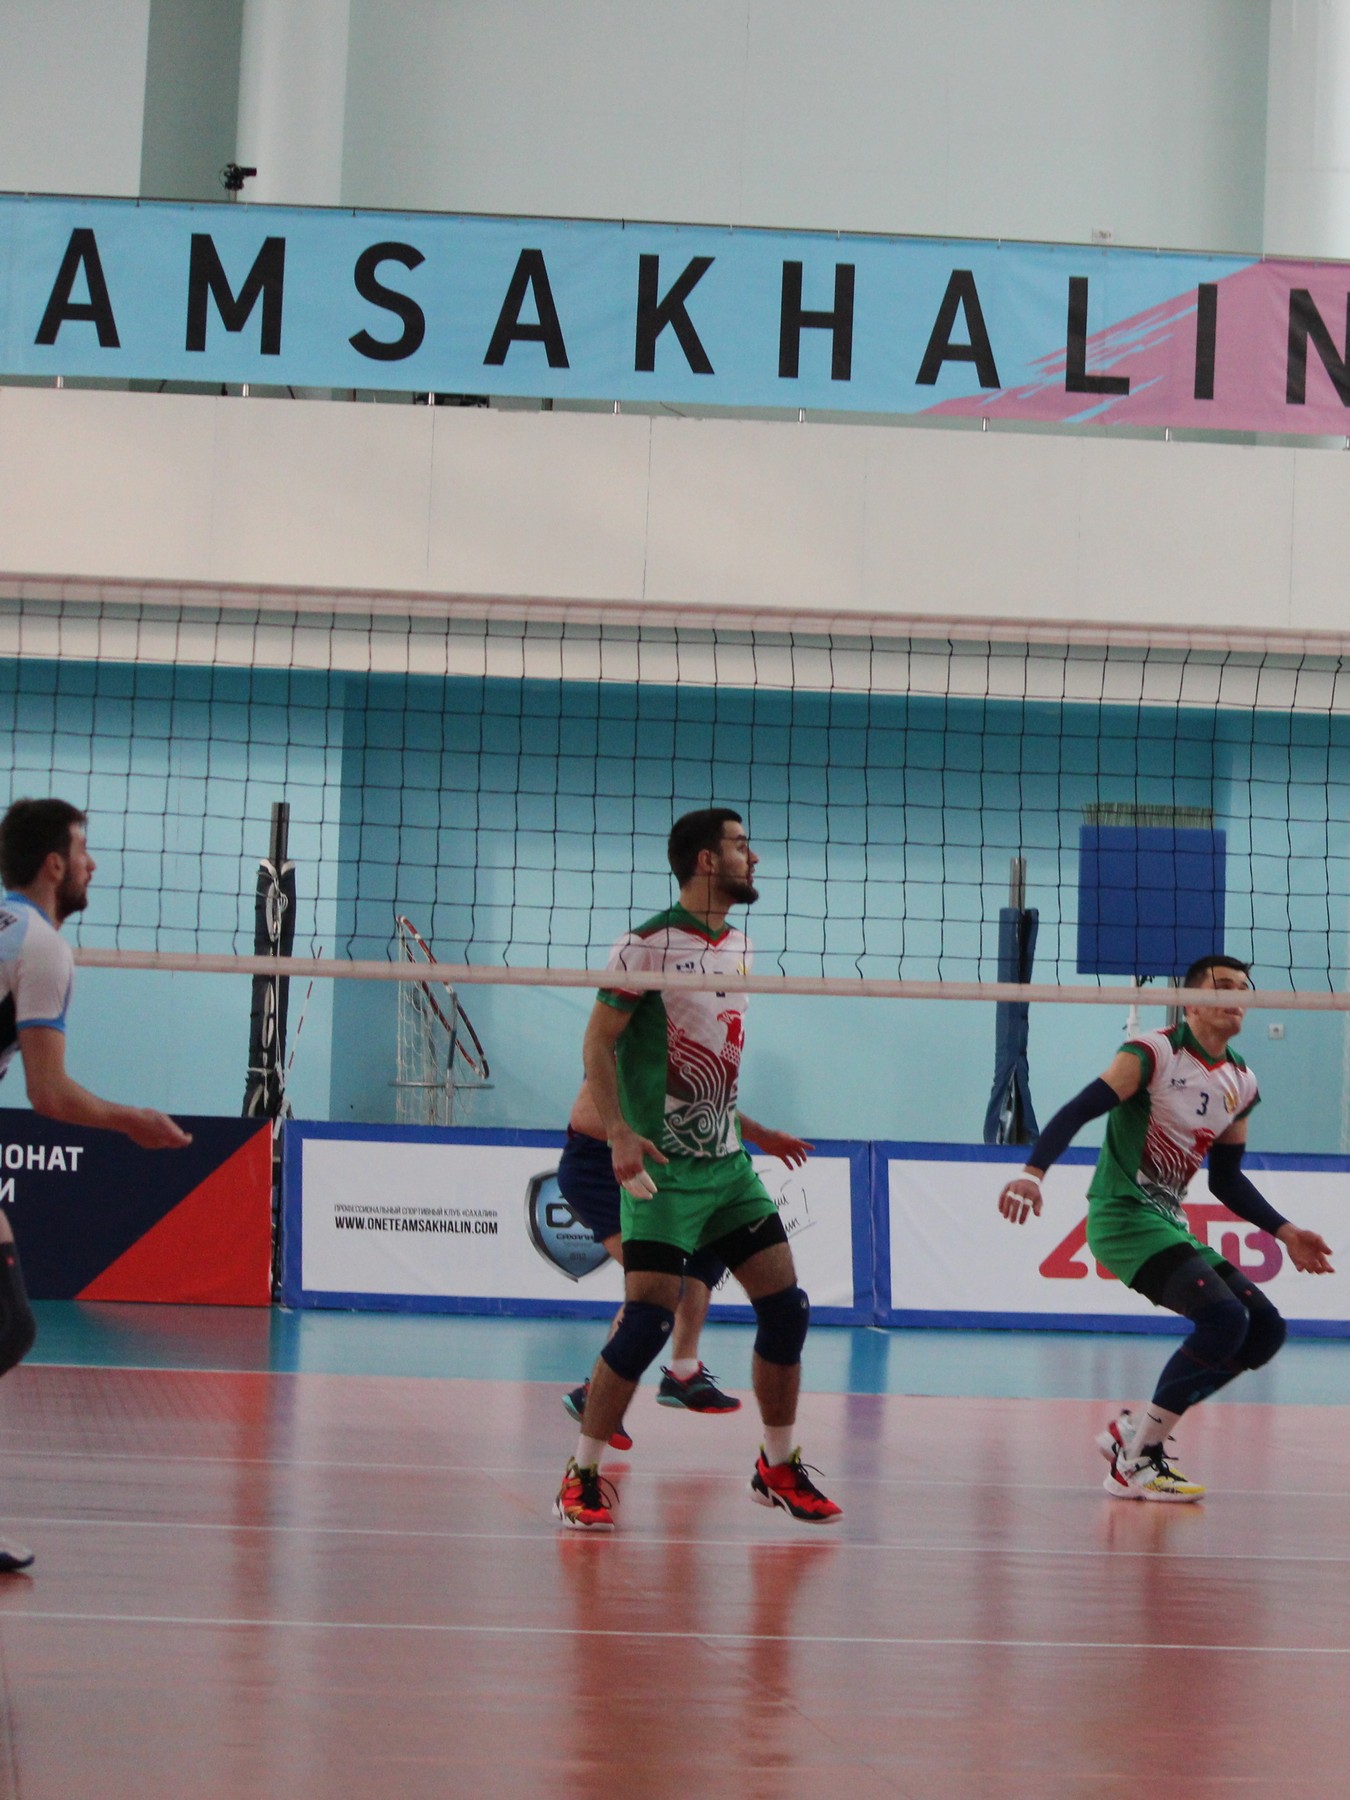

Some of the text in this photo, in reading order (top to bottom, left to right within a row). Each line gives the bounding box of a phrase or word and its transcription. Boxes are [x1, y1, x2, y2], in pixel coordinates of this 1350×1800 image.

[1196, 1091, 1210, 1116] 3
[0, 1143, 84, 1171] ОНАТ
[334, 1204, 401, 1215] ПРОФЕССИОНАЛЬНЫЙ
[402, 1207, 443, 1216] СПОРТИВНЫЙ
[444, 1208, 461, 1217] КЛУБ
[335, 1216, 498, 1234] WWW.ONETEAMSAKHALIN.COM
